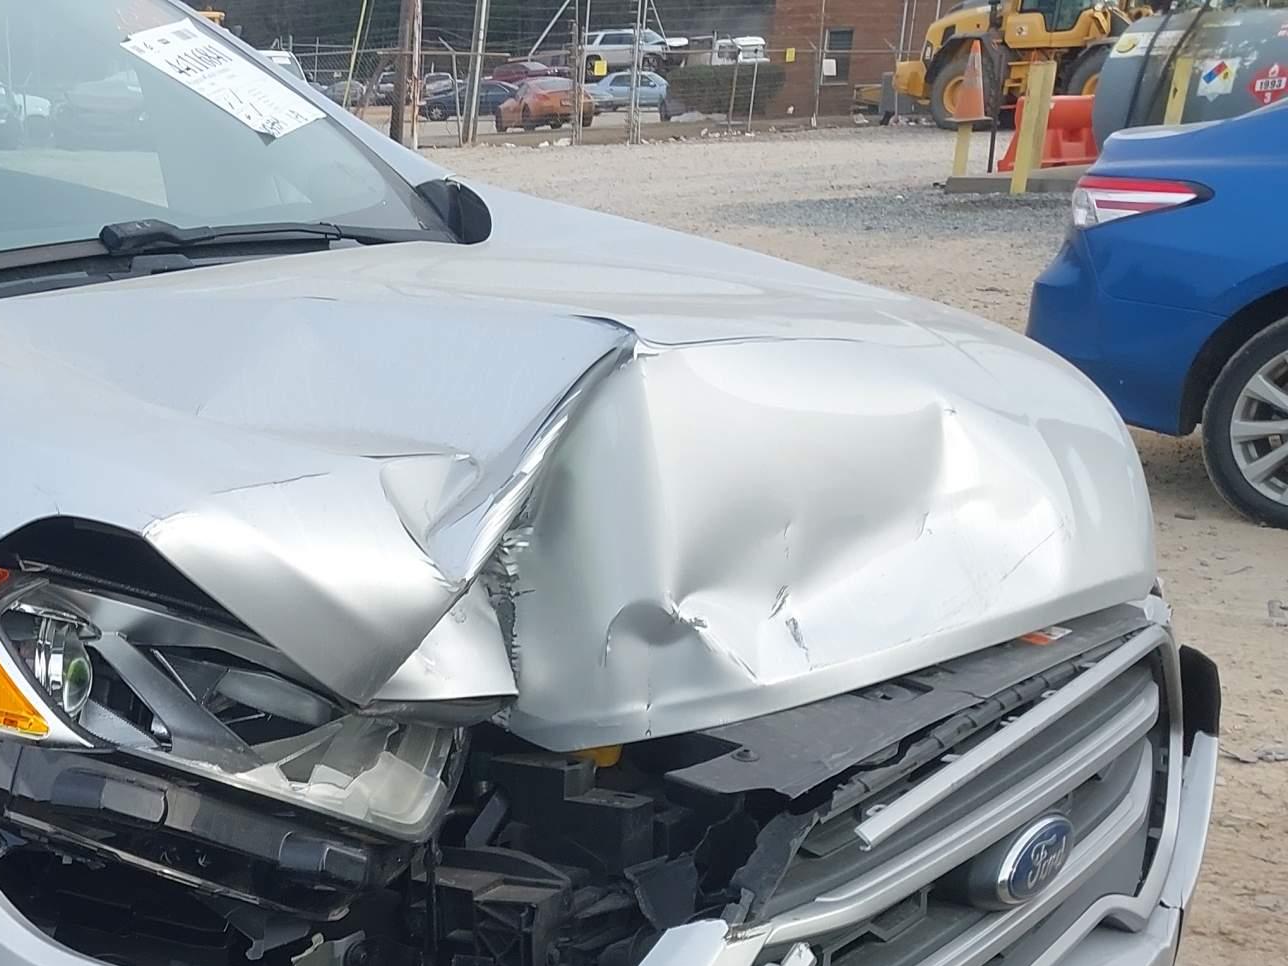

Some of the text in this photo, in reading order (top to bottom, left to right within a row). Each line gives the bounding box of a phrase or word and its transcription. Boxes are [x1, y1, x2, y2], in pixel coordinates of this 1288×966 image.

[164, 44, 233, 77] 44116841
[1259, 80, 1282, 90] 1993
[1263, 92, 1272, 103] 3
[1027, 833, 1067, 890] Ford
